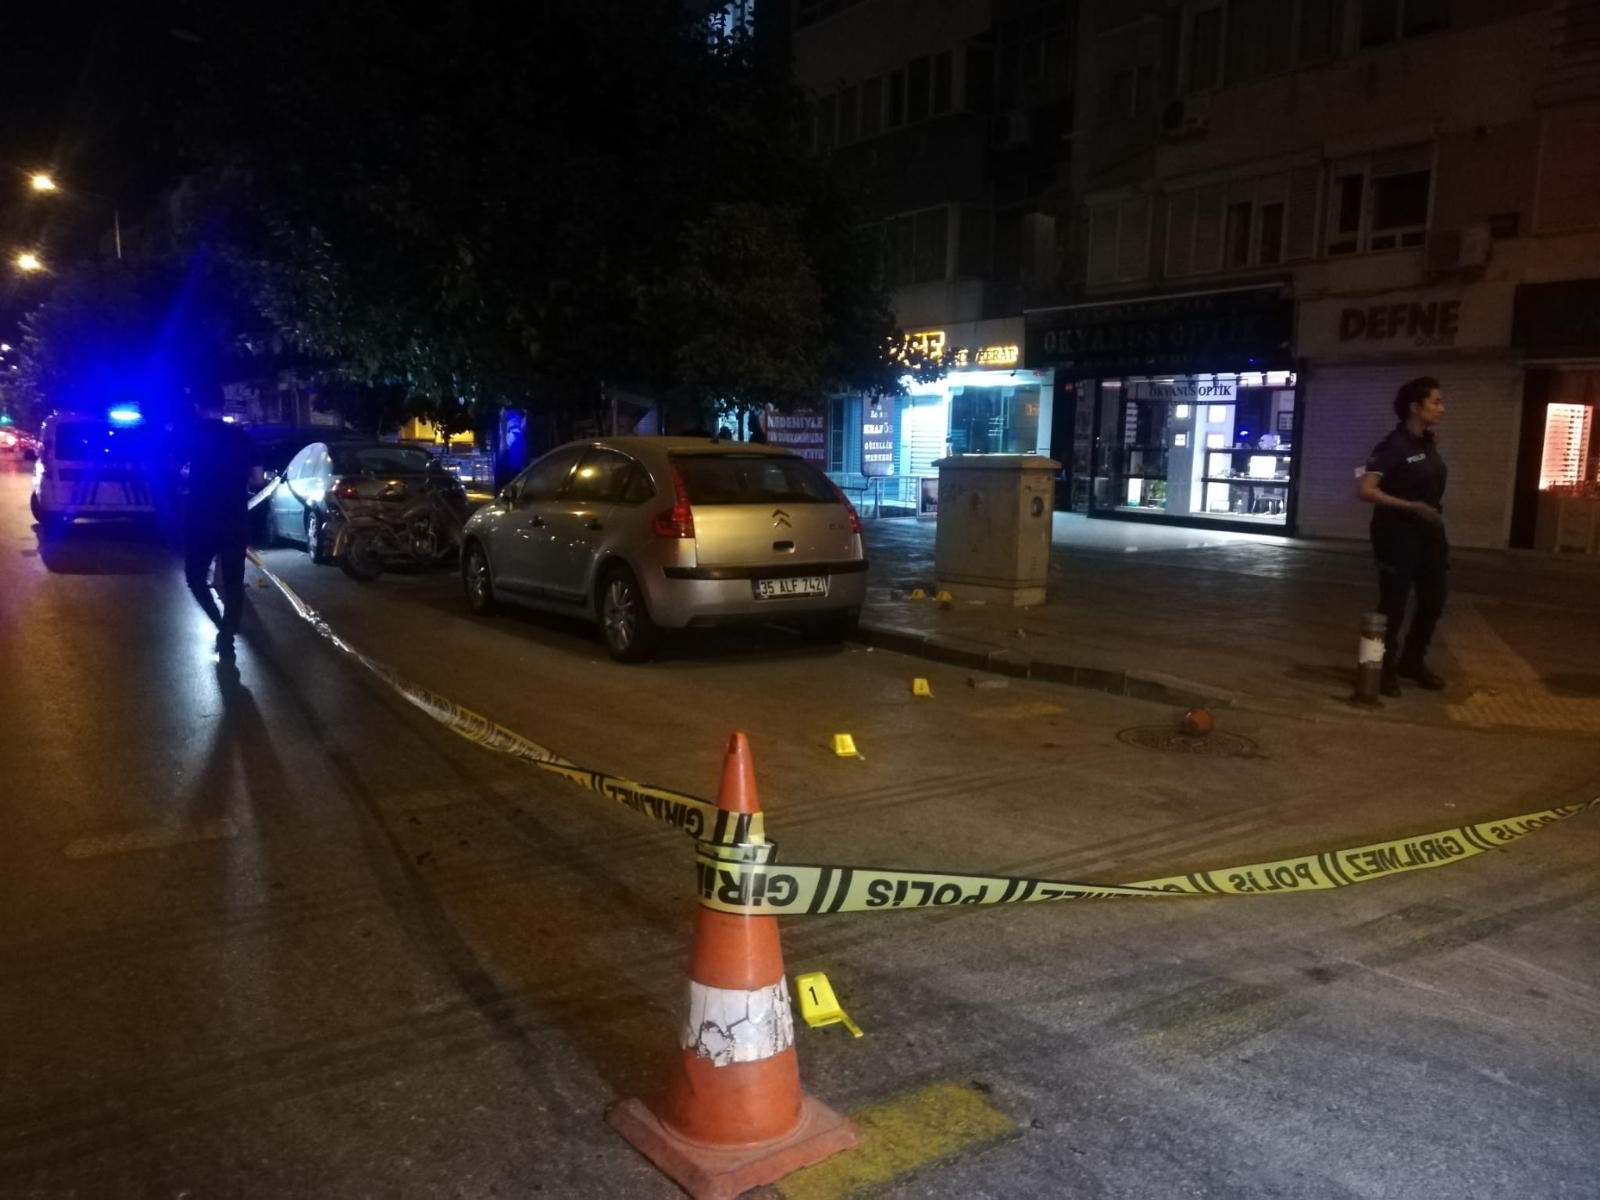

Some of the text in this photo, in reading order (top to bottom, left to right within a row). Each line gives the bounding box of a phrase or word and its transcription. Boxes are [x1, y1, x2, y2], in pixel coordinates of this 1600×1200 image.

[1339, 300, 1461, 341] DEFNE
[1043, 325, 1160, 354] OKYANUS
[1149, 383, 1232, 397] OKYANUS OPTİK
[760, 578, 822, 595] 35 ALF 742
[866, 879, 988, 907] POLİS
[808, 985, 818, 1006] 1
